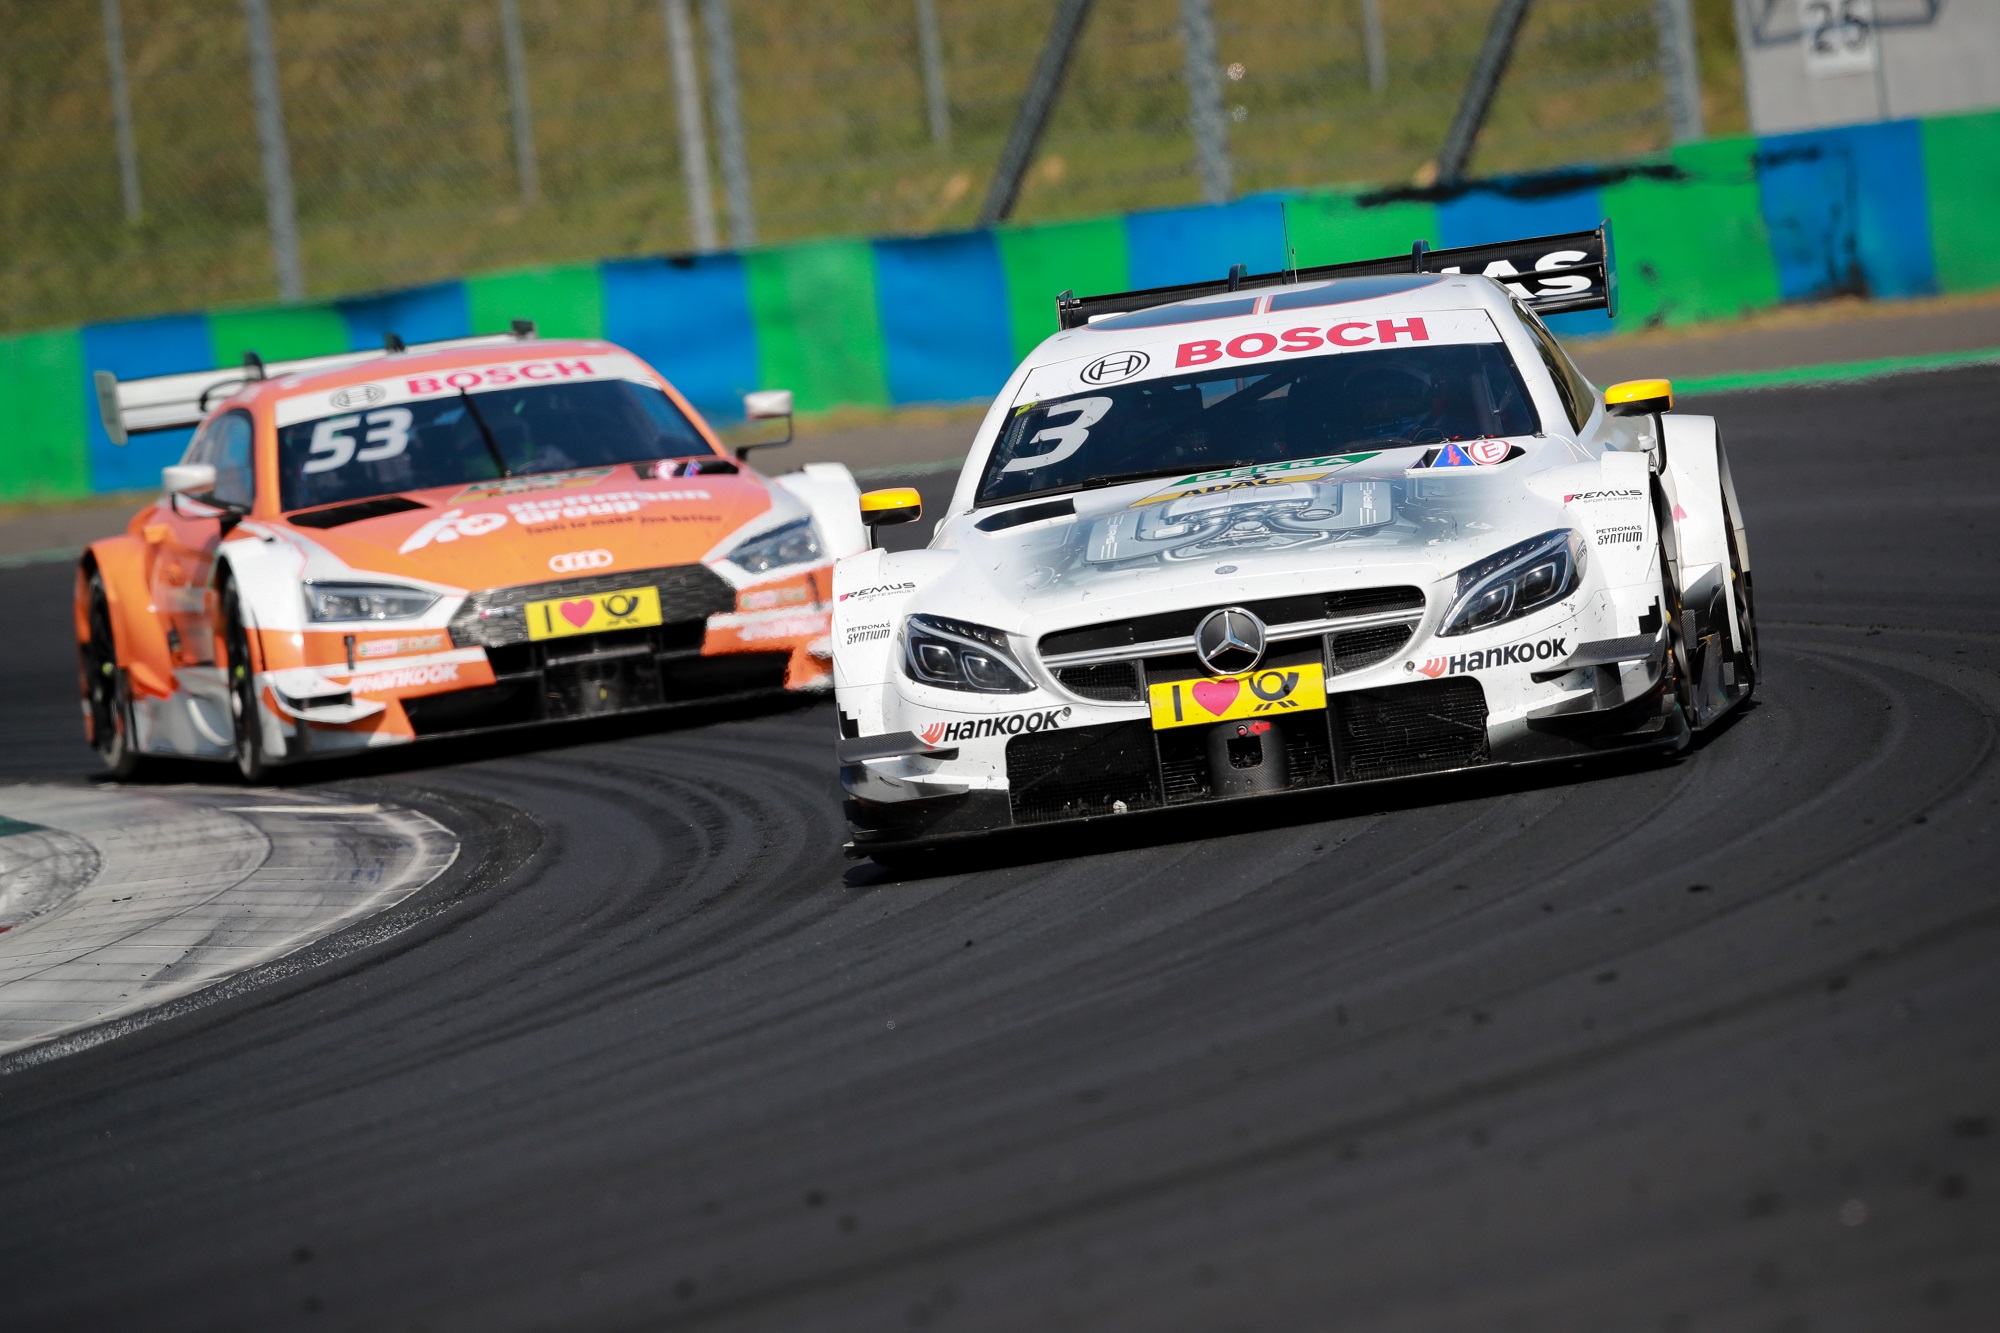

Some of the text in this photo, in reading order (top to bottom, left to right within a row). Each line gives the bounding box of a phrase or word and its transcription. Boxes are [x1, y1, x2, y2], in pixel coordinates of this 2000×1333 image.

[1175, 317, 1429, 368] BOSCH
[407, 361, 595, 395] BOSCH
[302, 407, 414, 475] 53
[1002, 397, 1114, 473] 3
[1178, 477, 1284, 498] ADAC
[1569, 489, 1643, 502] REMUS
[515, 500, 641, 525] Group
[1596, 525, 1642, 534] PETRONAS
[1597, 532, 1643, 546] SYNTIUM
[845, 582, 916, 600] REMUS
[846, 622, 891, 633] PETRONAS
[846, 629, 891, 645] SYNTIUM
[1172, 685, 1183, 722] I
